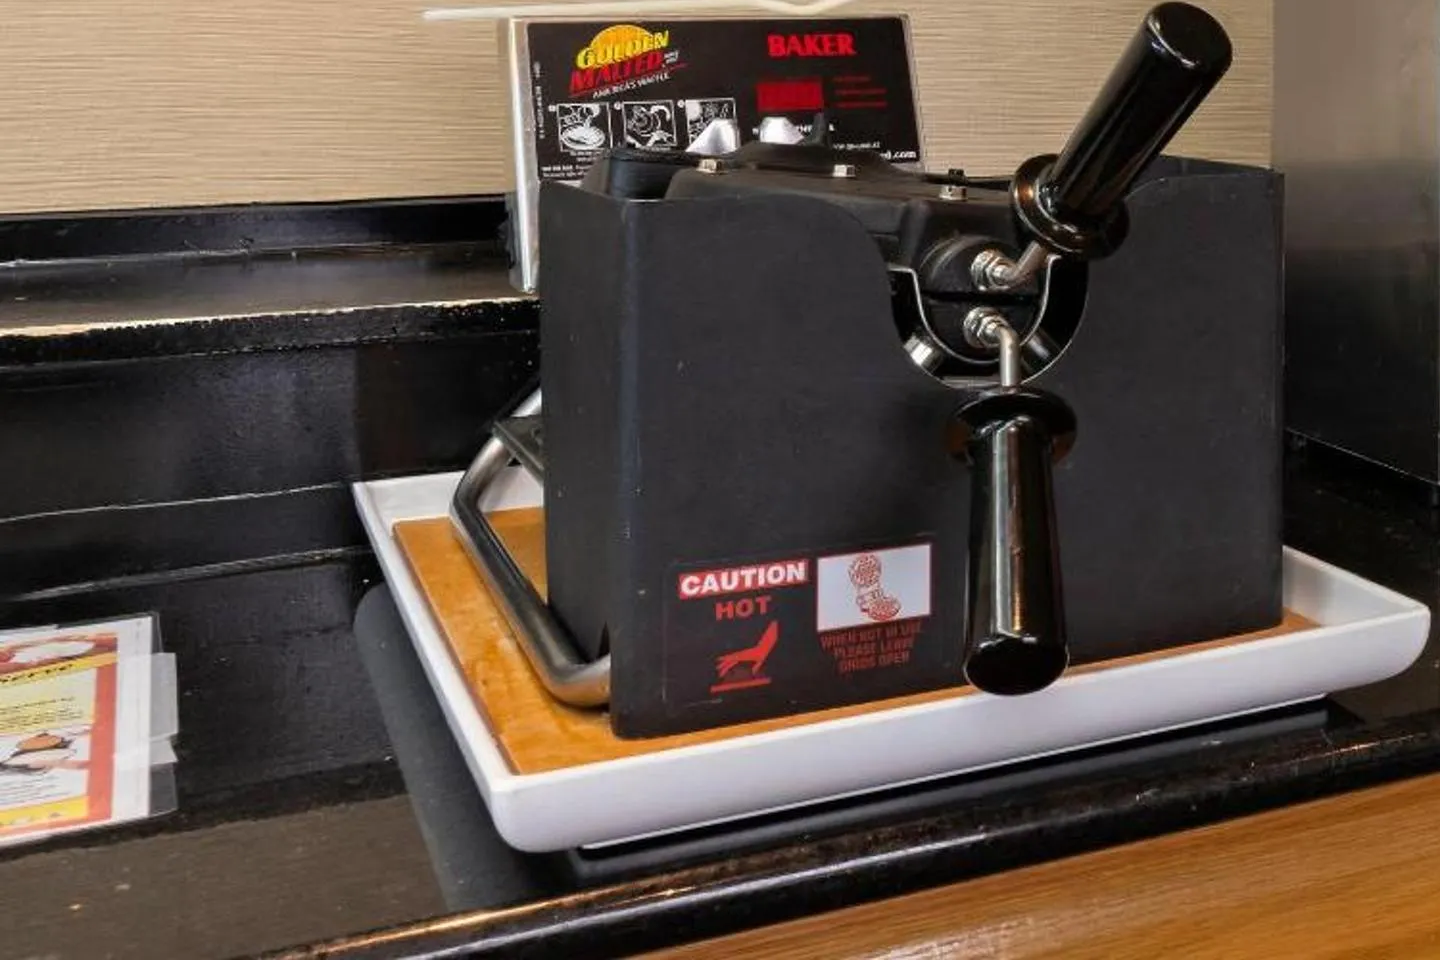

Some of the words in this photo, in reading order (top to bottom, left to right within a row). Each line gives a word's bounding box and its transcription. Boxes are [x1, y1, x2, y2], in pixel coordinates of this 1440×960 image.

[576, 29, 670, 70] GOLDEN
[767, 33, 856, 58] BAKER
[568, 50, 665, 96] MALTED
[680, 562, 807, 597] CAUTION
[715, 595, 772, 621] HOT
